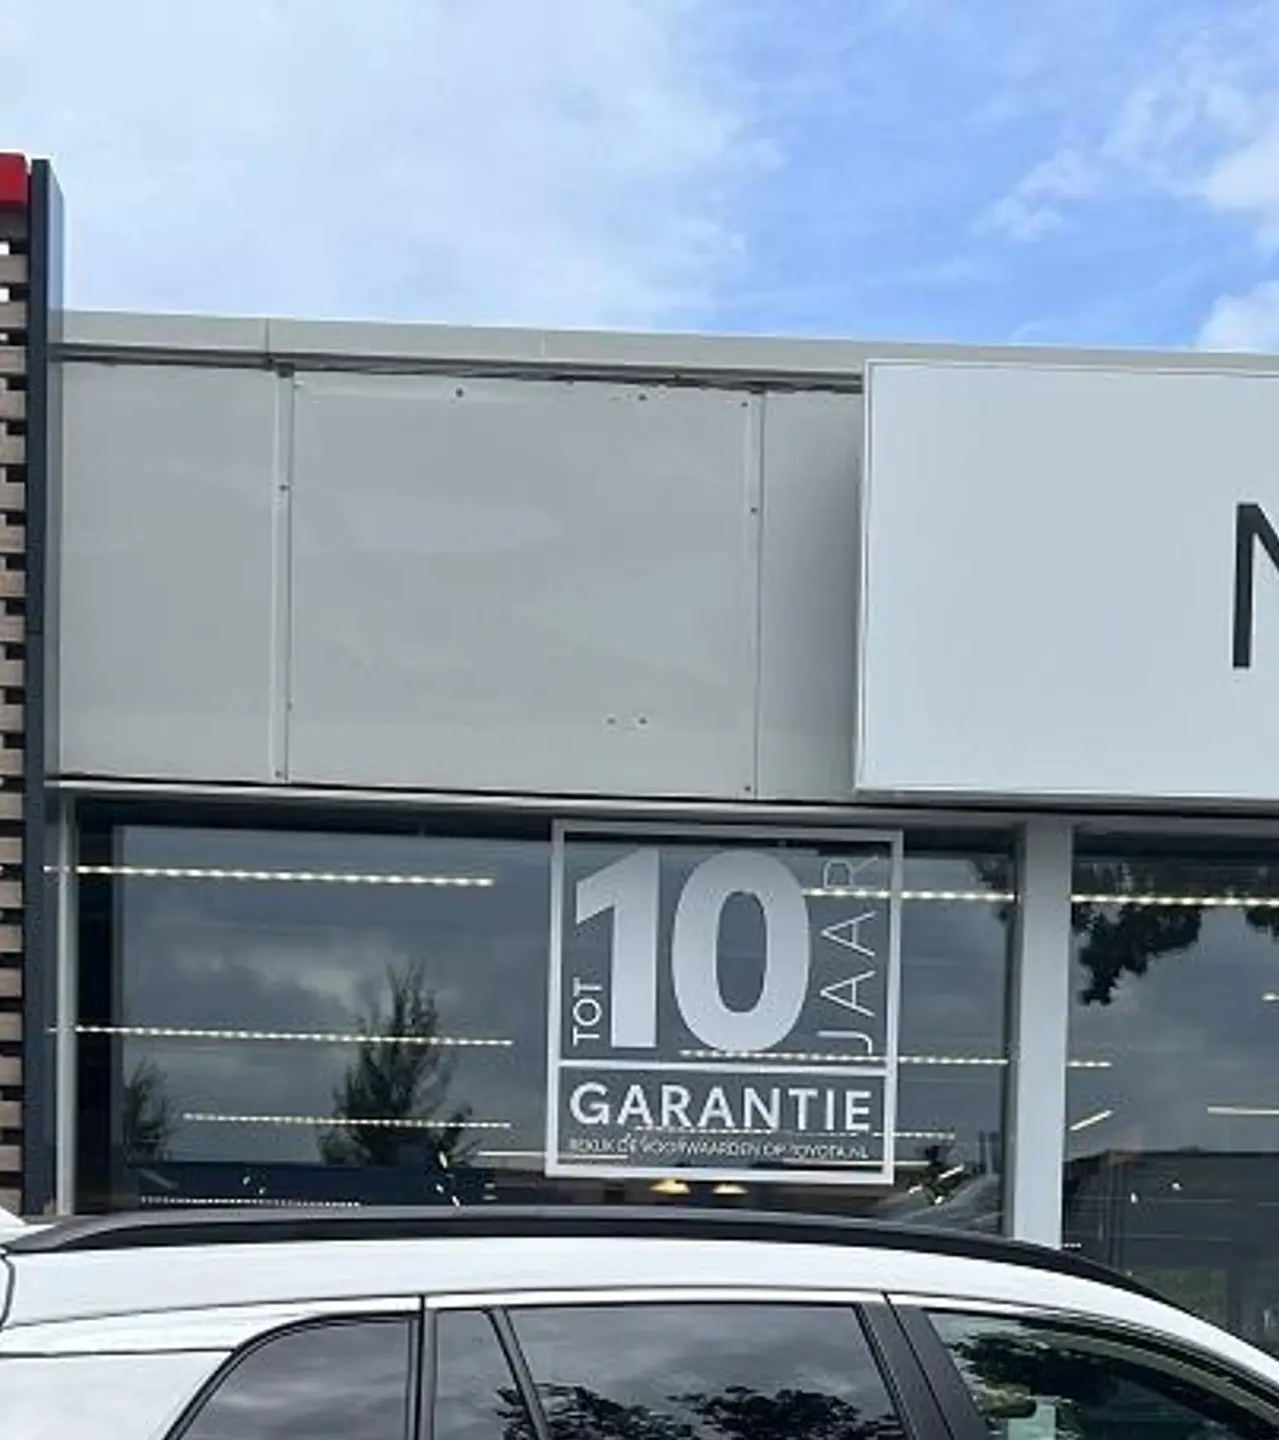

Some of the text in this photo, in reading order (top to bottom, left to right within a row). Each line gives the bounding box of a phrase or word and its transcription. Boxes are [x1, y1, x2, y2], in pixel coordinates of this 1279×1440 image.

[572, 976, 603, 1047] TOT
[575, 847, 811, 1053] 10
[817, 855, 879, 1055] JAAR
[568, 1081, 872, 1132] GARANTIE
